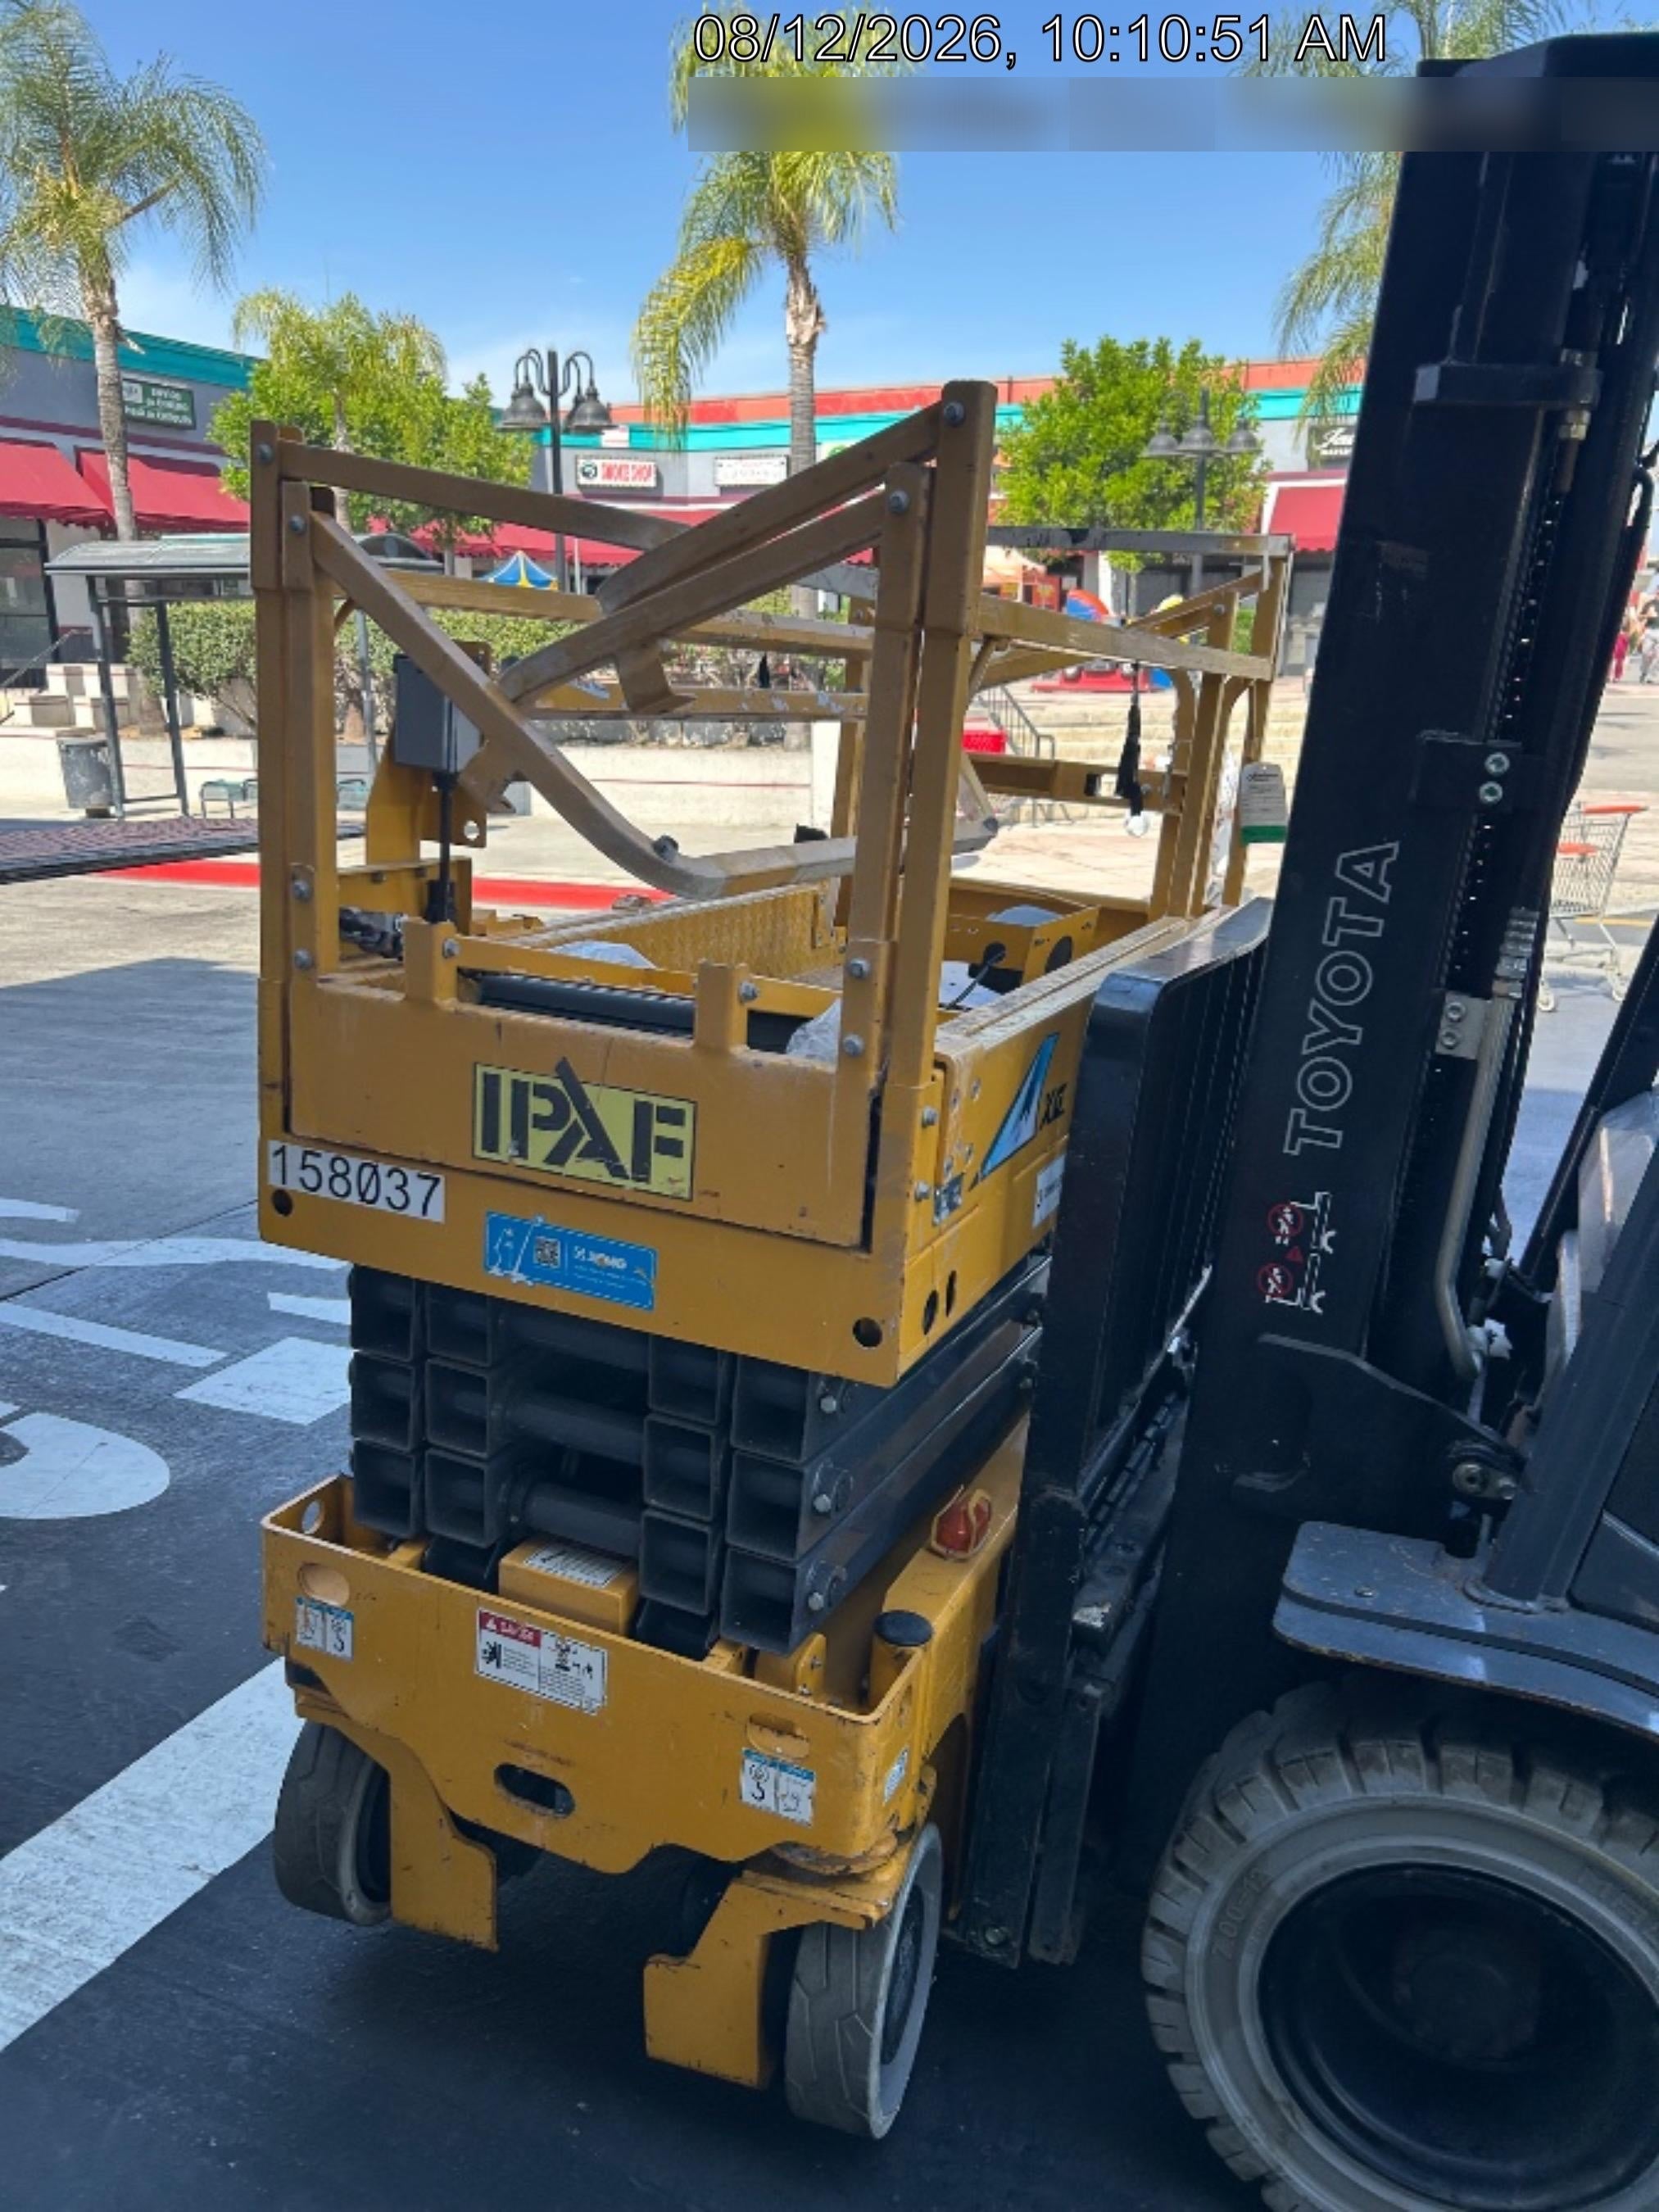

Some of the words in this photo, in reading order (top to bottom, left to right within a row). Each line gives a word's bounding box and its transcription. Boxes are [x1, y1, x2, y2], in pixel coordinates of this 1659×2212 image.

[601, 462, 630, 482] SMOKE
[632, 464, 652, 482] SHOP
[1282, 841, 1399, 1155] TOYOTA
[482, 1057, 686, 1184] IPAF
[271, 1145, 442, 1217] 158037
